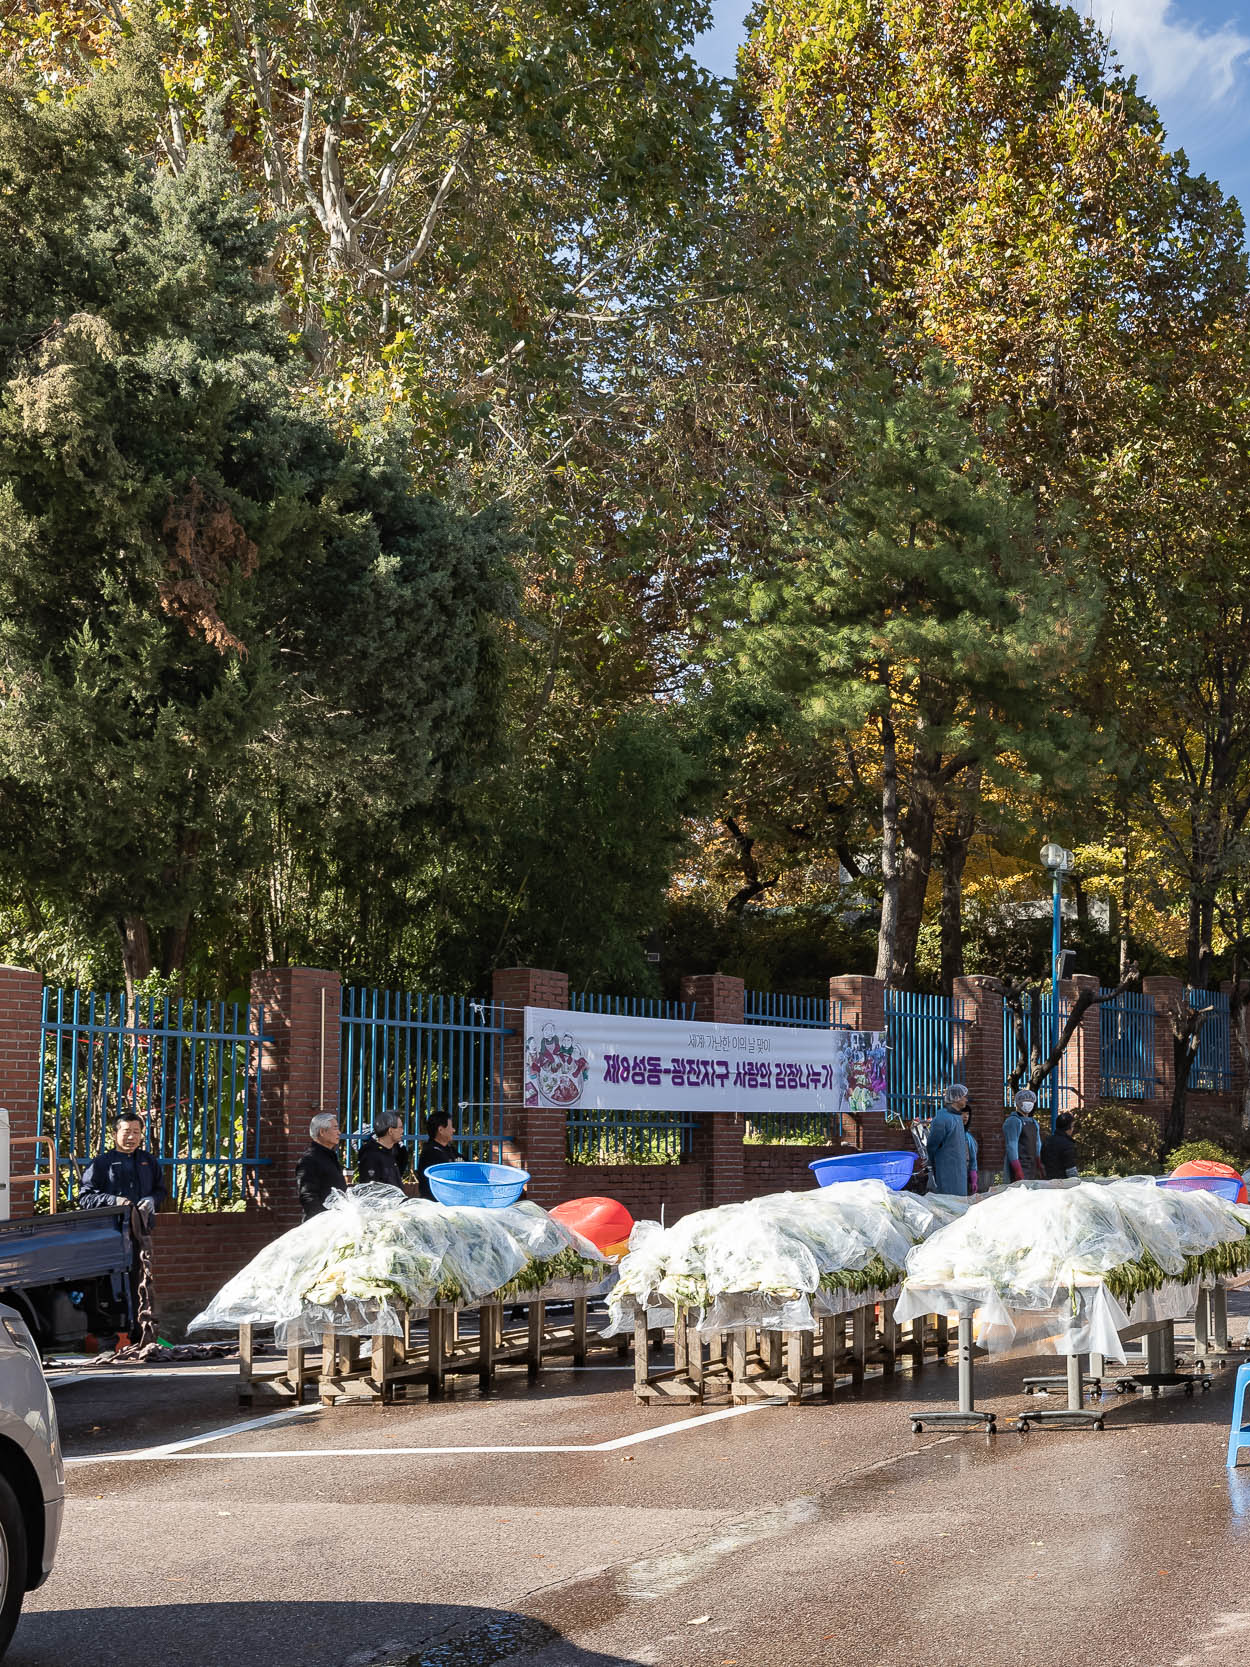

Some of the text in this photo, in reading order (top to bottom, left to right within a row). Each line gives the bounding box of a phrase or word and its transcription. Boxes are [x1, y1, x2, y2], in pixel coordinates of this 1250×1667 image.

[688, 1032, 771, 1055] 세계 가난한 이의 날 맞이
[603, 1054, 834, 1090] 제8성동-광진지구 사랑의 김장나누기
